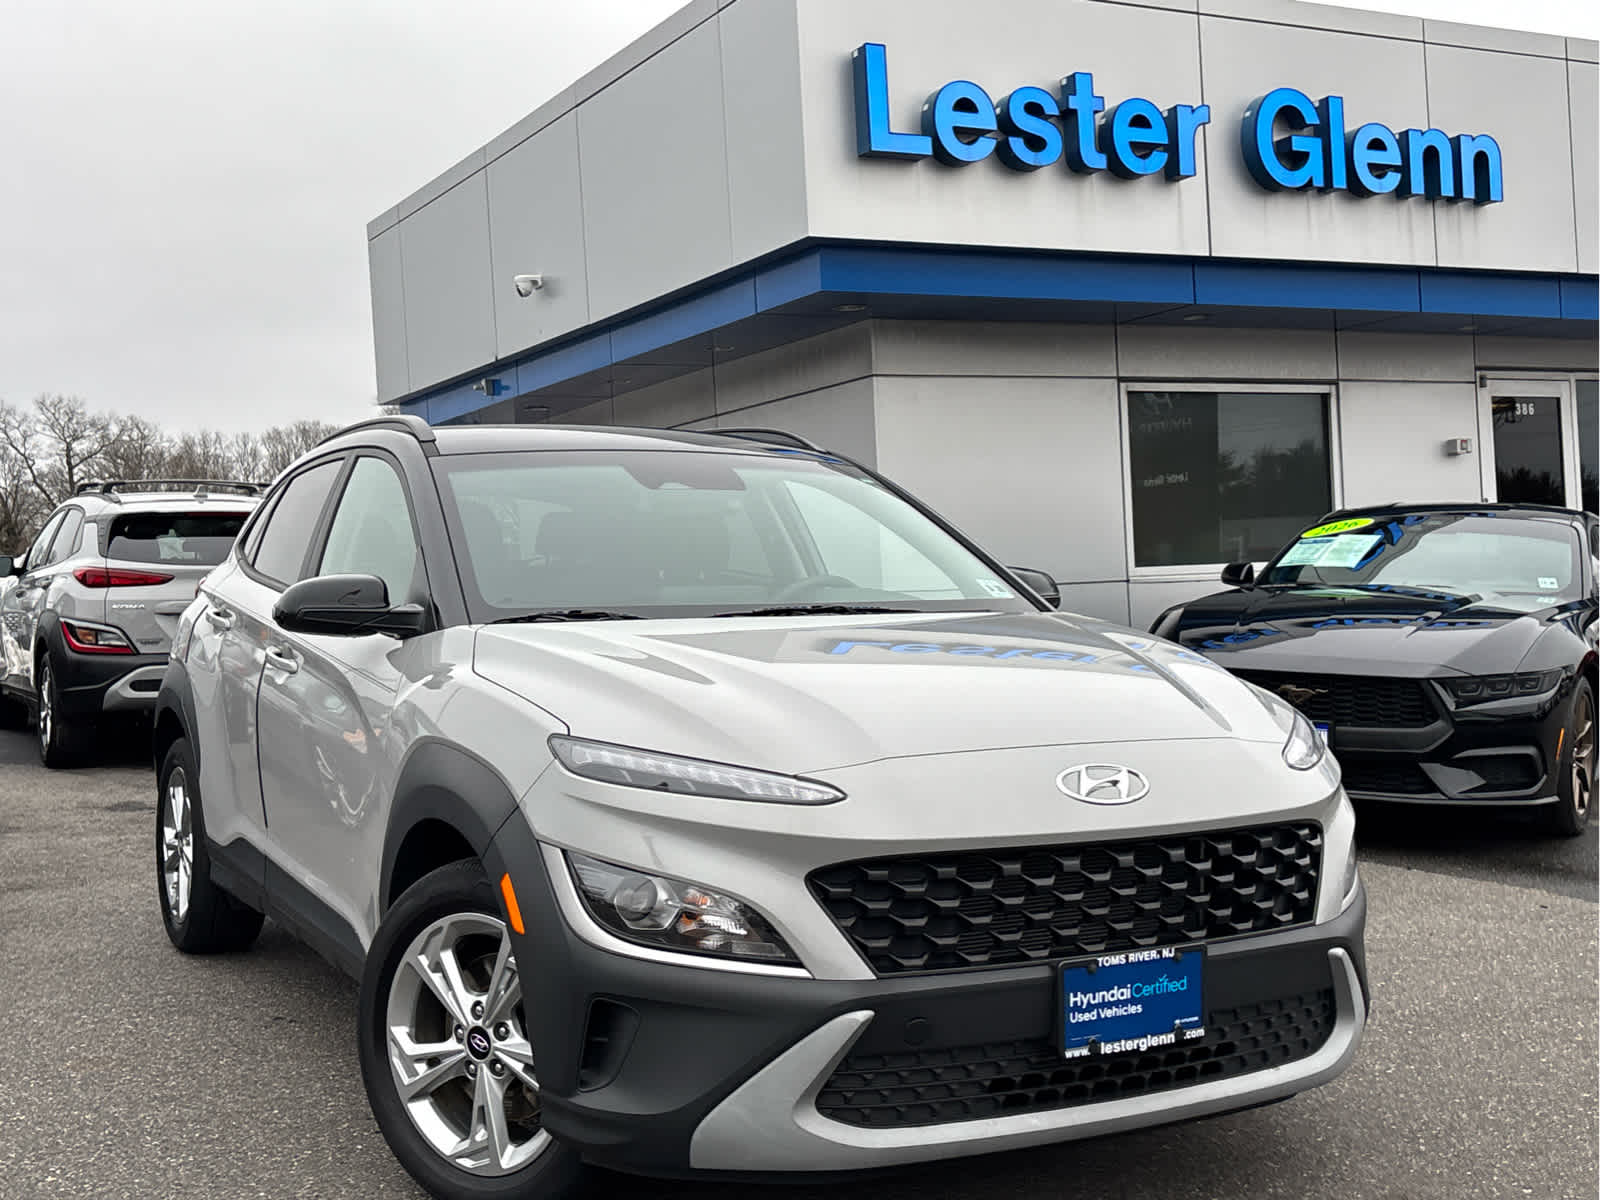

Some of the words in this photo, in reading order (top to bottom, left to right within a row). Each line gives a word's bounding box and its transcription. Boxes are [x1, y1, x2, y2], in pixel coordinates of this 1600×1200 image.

[852, 42, 1209, 182] Lester
[1242, 87, 1504, 204] Glenn
[1515, 403, 1535, 415] 386
[1097, 954, 1126, 968] TOMS
[1162, 947, 1175, 958] NJ
[1069, 984, 1131, 1008] Hyundai
[1132, 975, 1187, 998] Certified
[1069, 1008, 1097, 1023] Used
[1099, 1003, 1143, 1019] Vehicles
[1101, 1034, 1175, 1055] lesterglenn
[1183, 1028, 1205, 1040] .com
